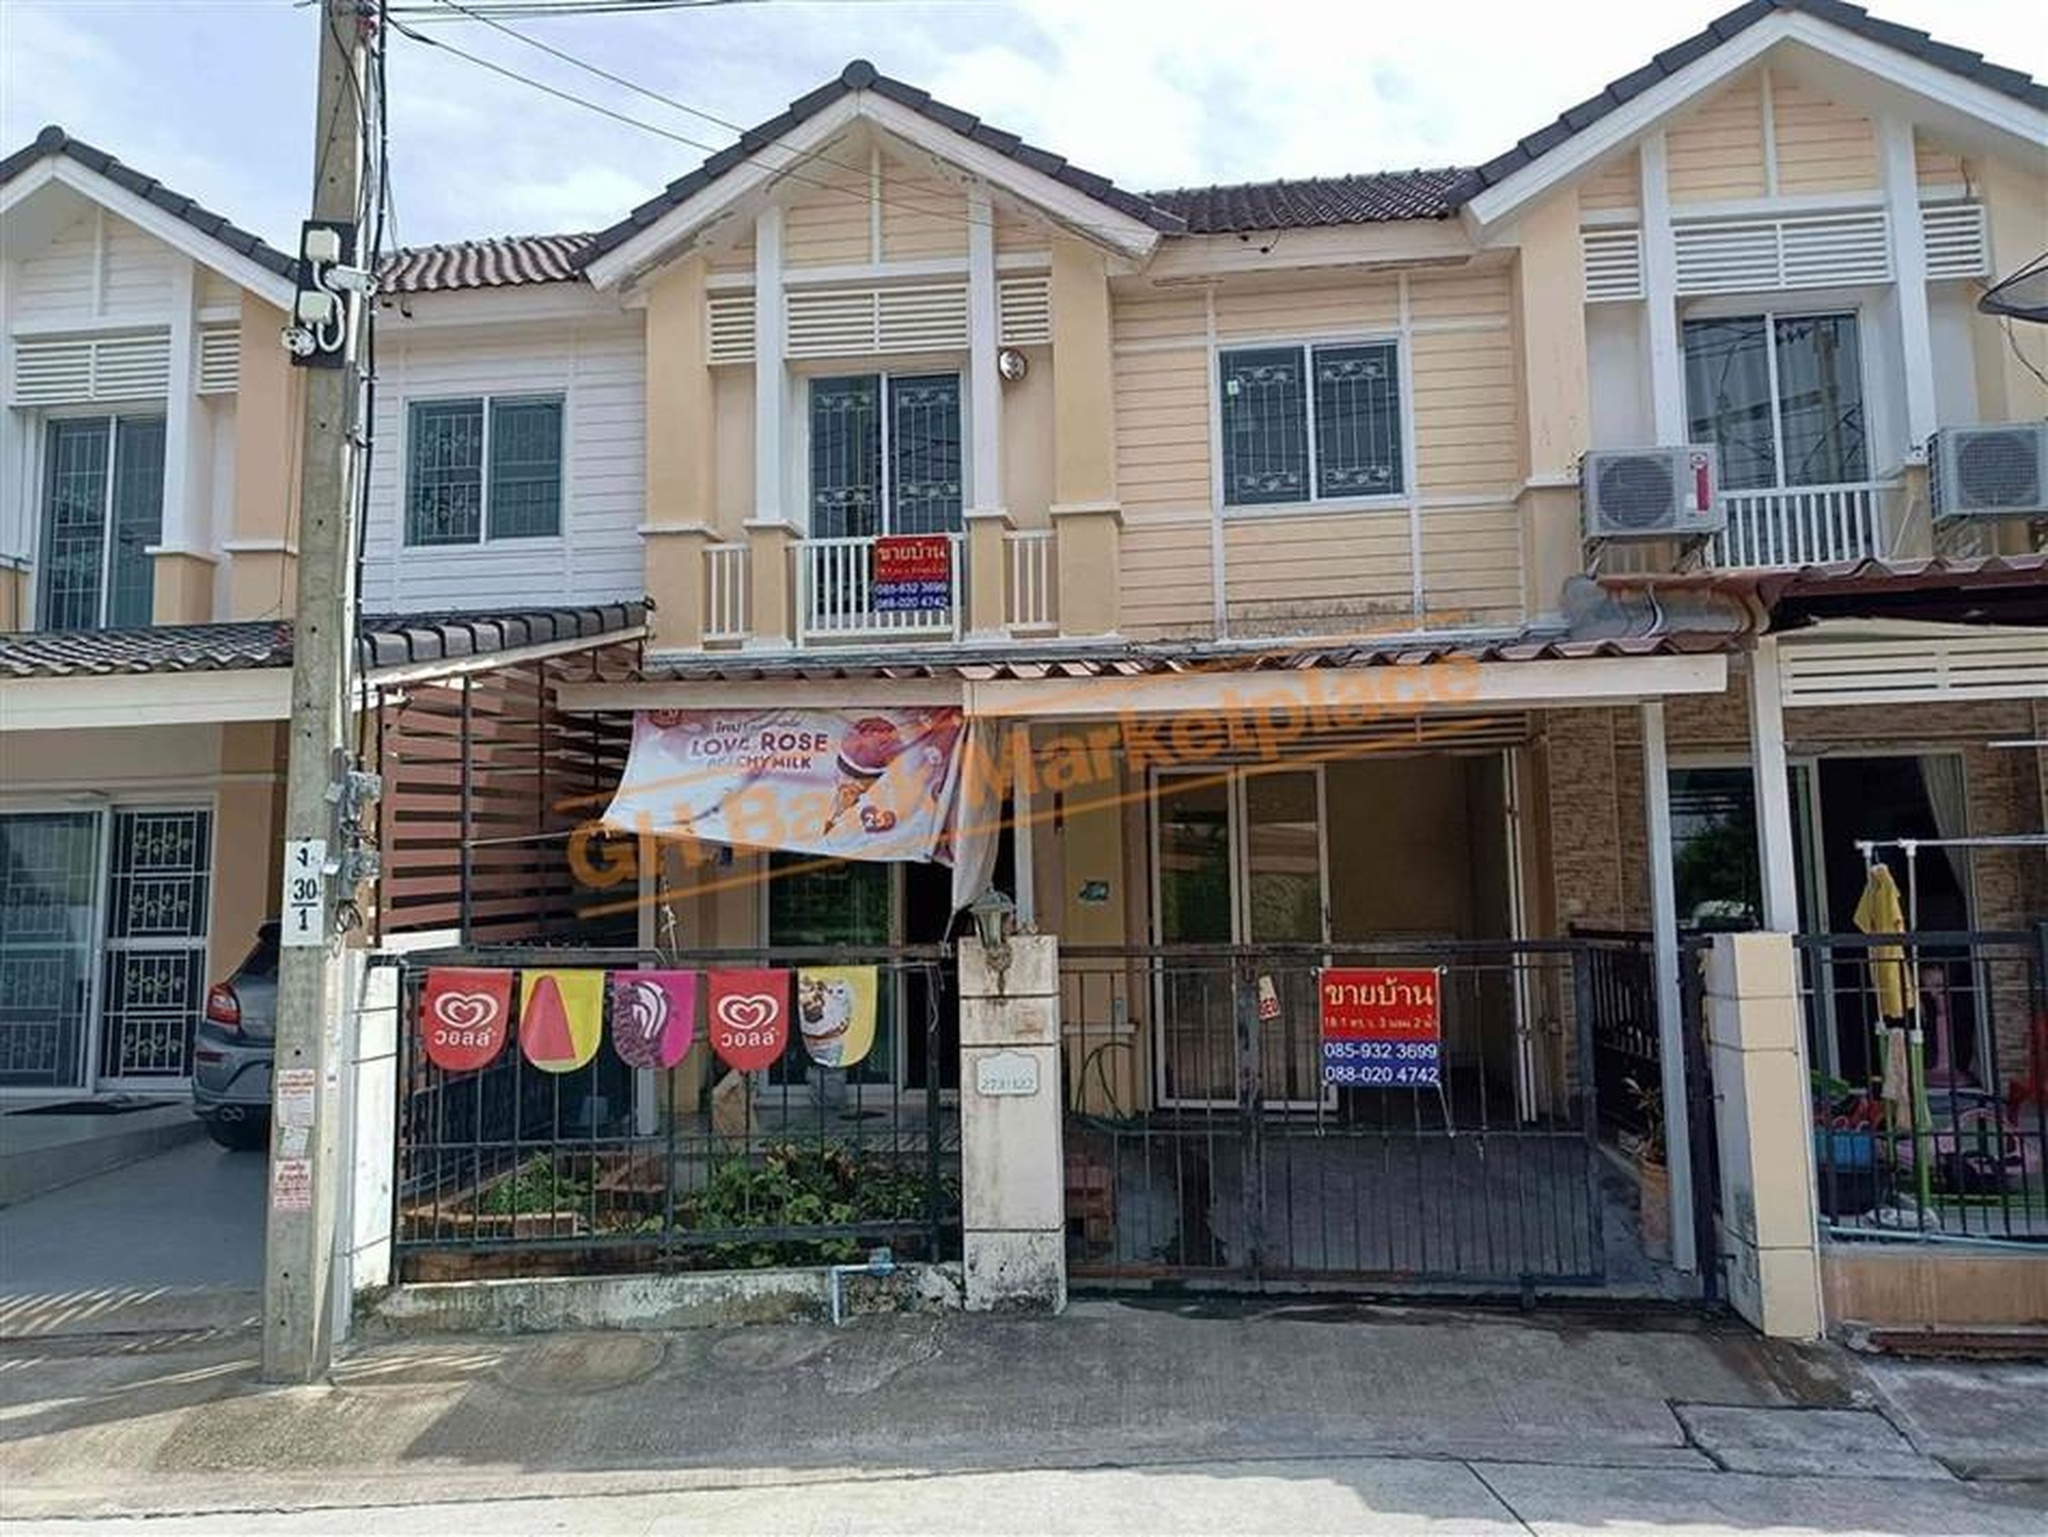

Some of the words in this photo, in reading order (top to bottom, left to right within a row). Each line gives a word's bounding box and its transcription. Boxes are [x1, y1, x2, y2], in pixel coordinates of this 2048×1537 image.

[761, 732, 828, 752] ROSE
[773, 757, 812, 769] MILK
[293, 878, 317, 899] 30
[299, 908, 308, 931] 1
[1325, 976, 1434, 1006] ขายบ้าน
[434, 1026, 492, 1046] วอลล์
[721, 1027, 775, 1047] วอลล์
[1324, 1043, 1393, 1058] 085-932
[1396, 1043, 1438, 1059] 3699
[1325, 1066, 1394, 1082] 088-020
[1397, 1067, 1439, 1082] 4742
